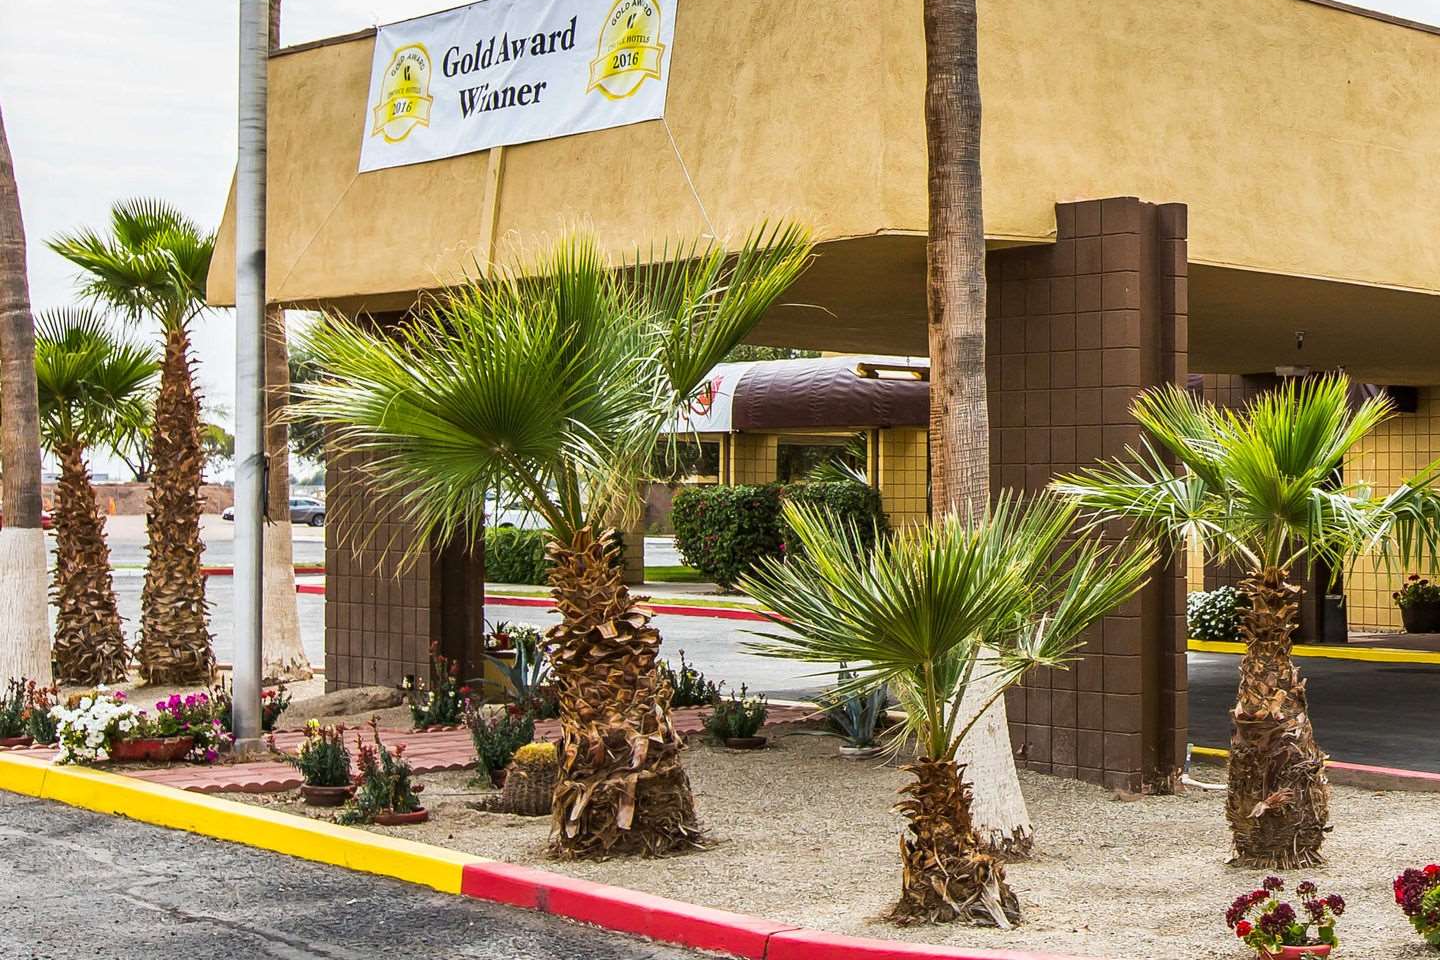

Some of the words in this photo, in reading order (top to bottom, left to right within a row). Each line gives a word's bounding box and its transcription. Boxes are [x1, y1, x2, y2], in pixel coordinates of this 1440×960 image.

[611, 2, 630, 26] GOLD
[443, 36, 496, 77] Gold
[495, 15, 577, 65] Award
[391, 56, 405, 76] GOD
[613, 52, 639, 69] 2016
[392, 102, 412, 116] 2016
[459, 82, 547, 119] Winner
